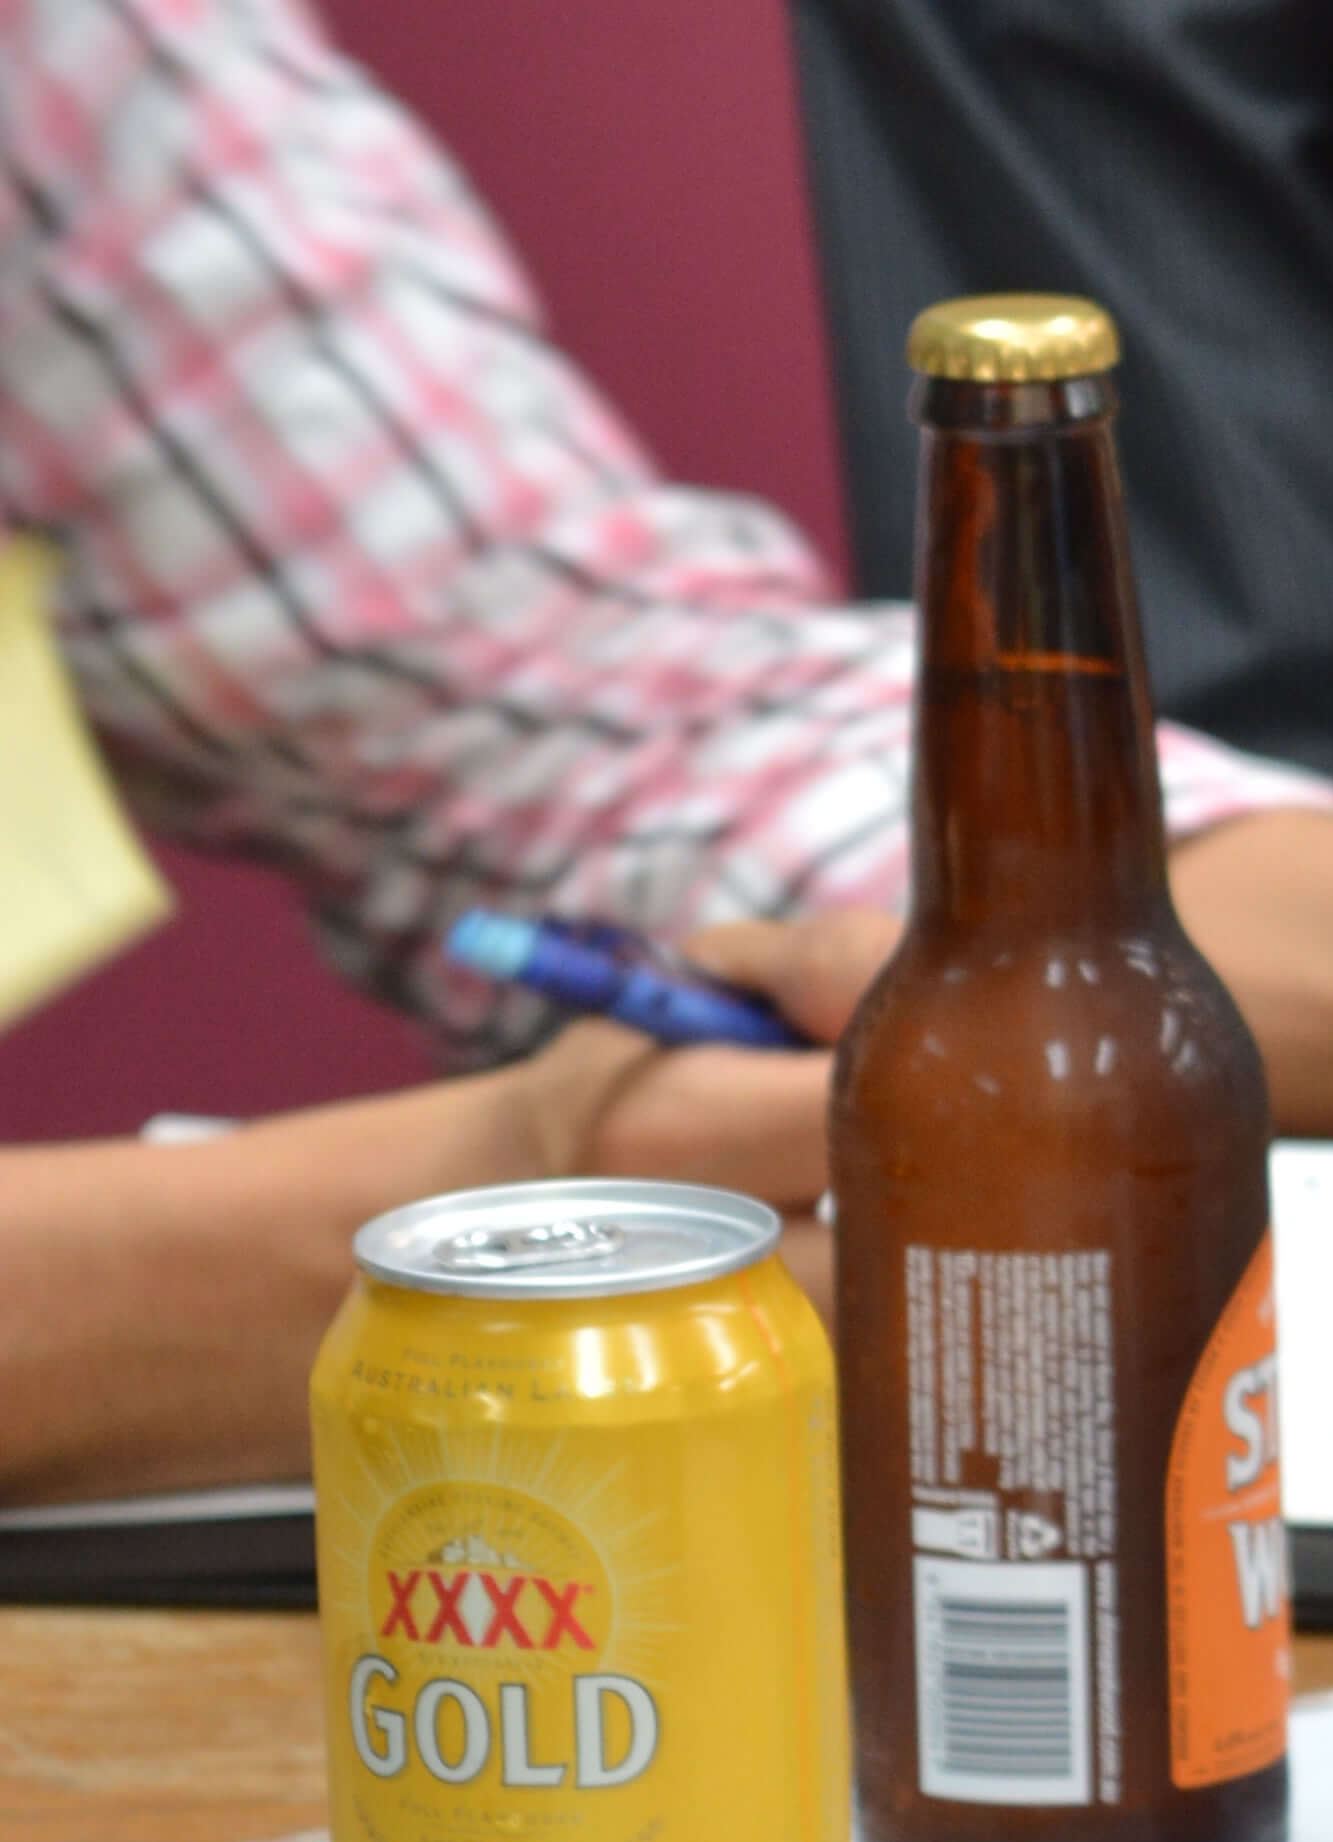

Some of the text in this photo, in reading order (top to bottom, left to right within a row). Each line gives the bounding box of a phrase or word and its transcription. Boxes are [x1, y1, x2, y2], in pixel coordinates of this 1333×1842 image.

[351, 1359, 517, 1400] AUSTRALIAN
[380, 1570, 598, 1651] XXXX
[348, 1653, 660, 1790] GOLD
